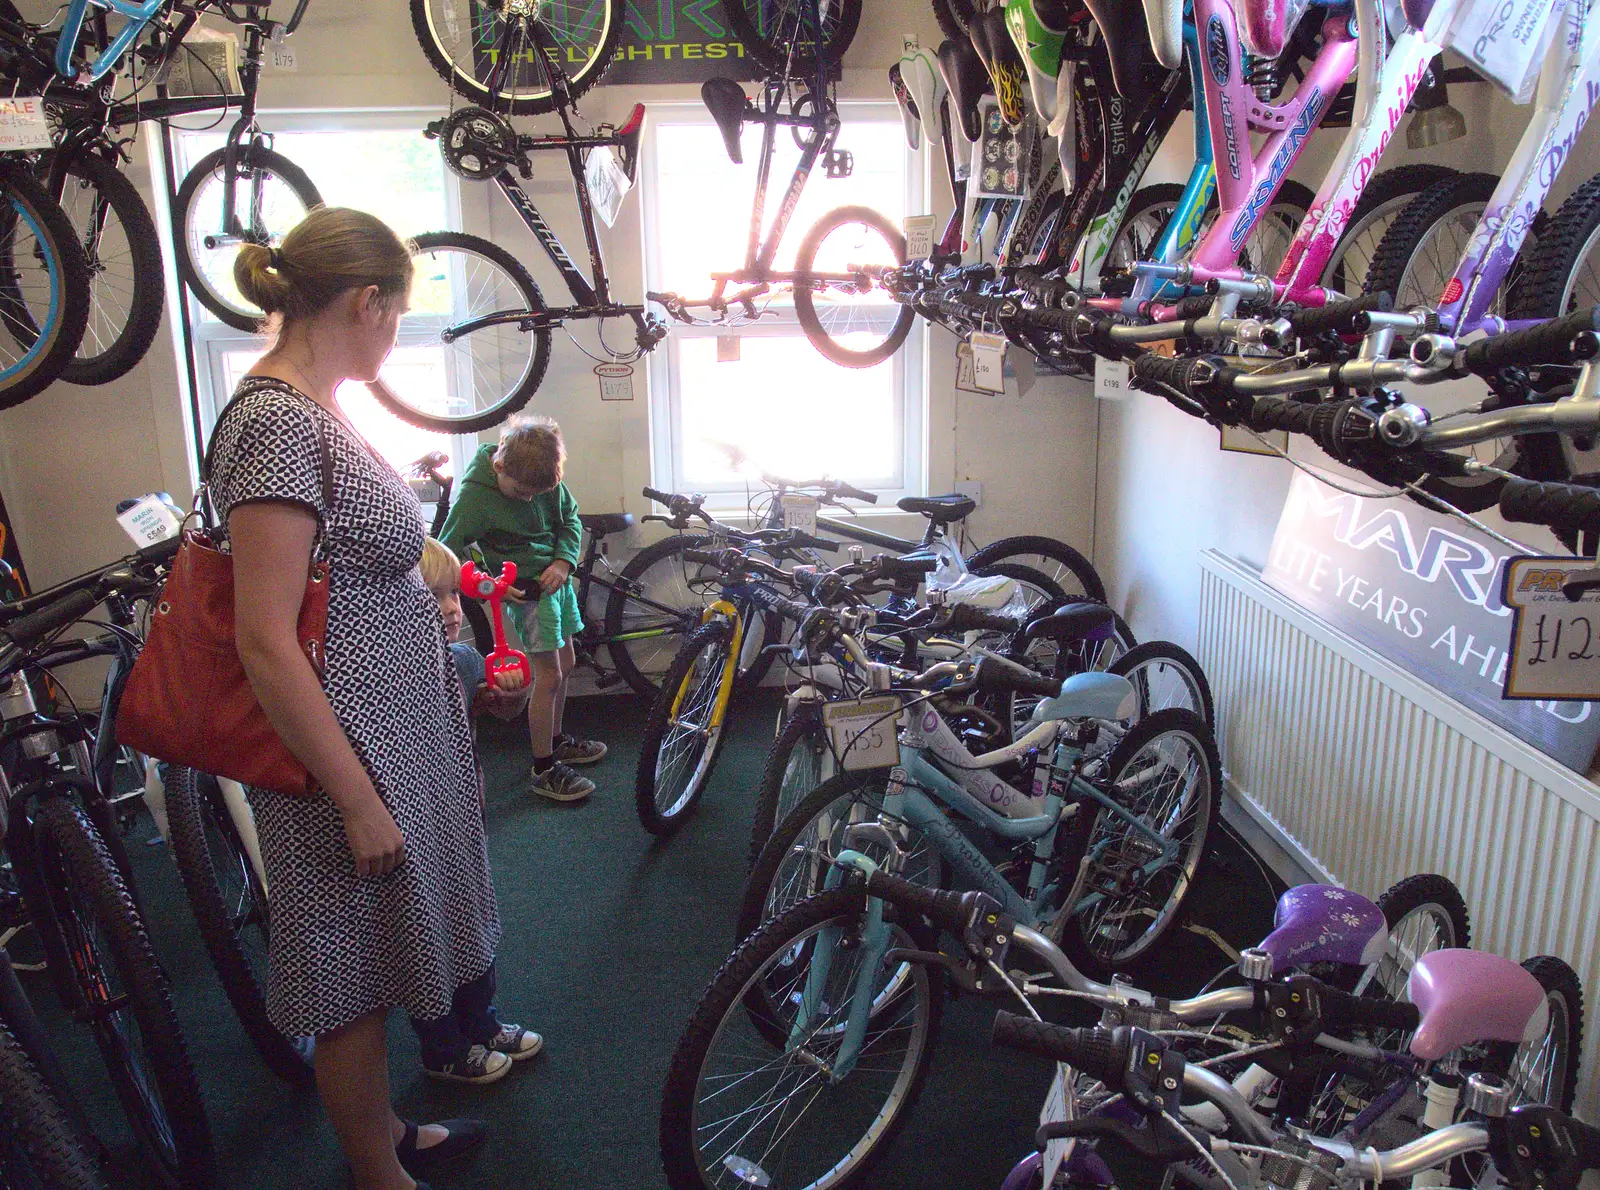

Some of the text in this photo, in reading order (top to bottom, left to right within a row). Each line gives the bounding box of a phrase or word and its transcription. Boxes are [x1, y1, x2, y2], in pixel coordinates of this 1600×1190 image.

[1099, 130, 1161, 245] PROBIKE
[1230, 86, 1327, 252] SKYLINE
[1103, 378, 1120, 389] £199
[132, 507, 153, 524] MARIN
[147, 524, 166, 541] £549
[1273, 536, 1332, 592] LITE
[1336, 566, 1429, 639] YEARS
[1528, 614, 1600, 666] £12
